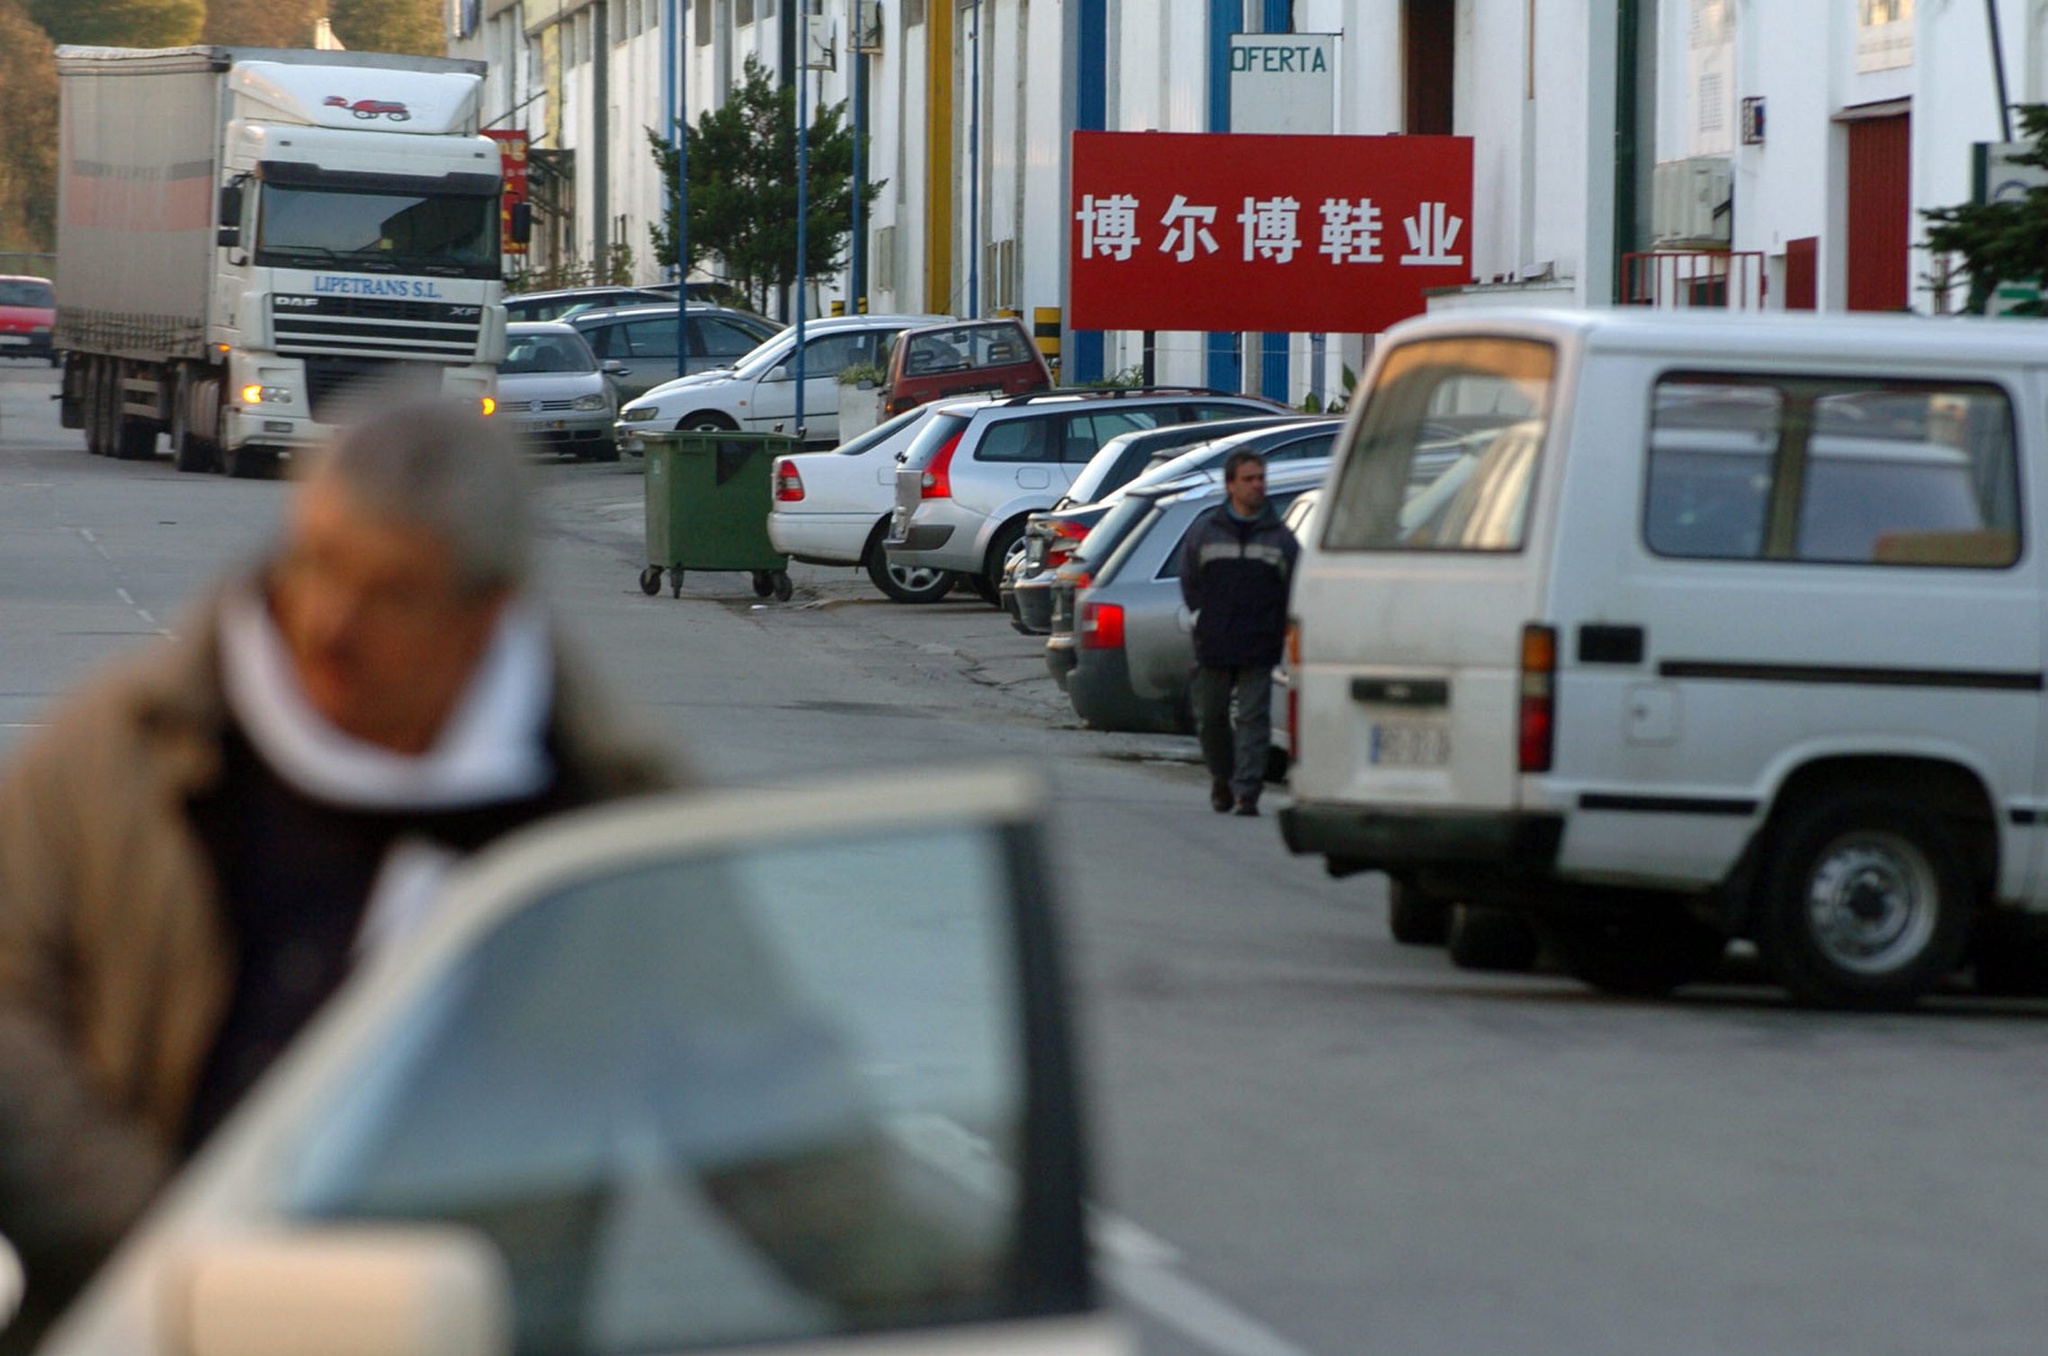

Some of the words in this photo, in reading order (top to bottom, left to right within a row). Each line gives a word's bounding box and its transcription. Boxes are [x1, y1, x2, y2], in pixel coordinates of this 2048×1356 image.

[1230, 46, 1326, 72] OFERTA
[1075, 194, 1463, 266] 博尔博鞋业
[314, 275, 407, 297] LIPETRANS
[412, 281, 443, 299] S.L.
[275, 296, 320, 307] DAF
